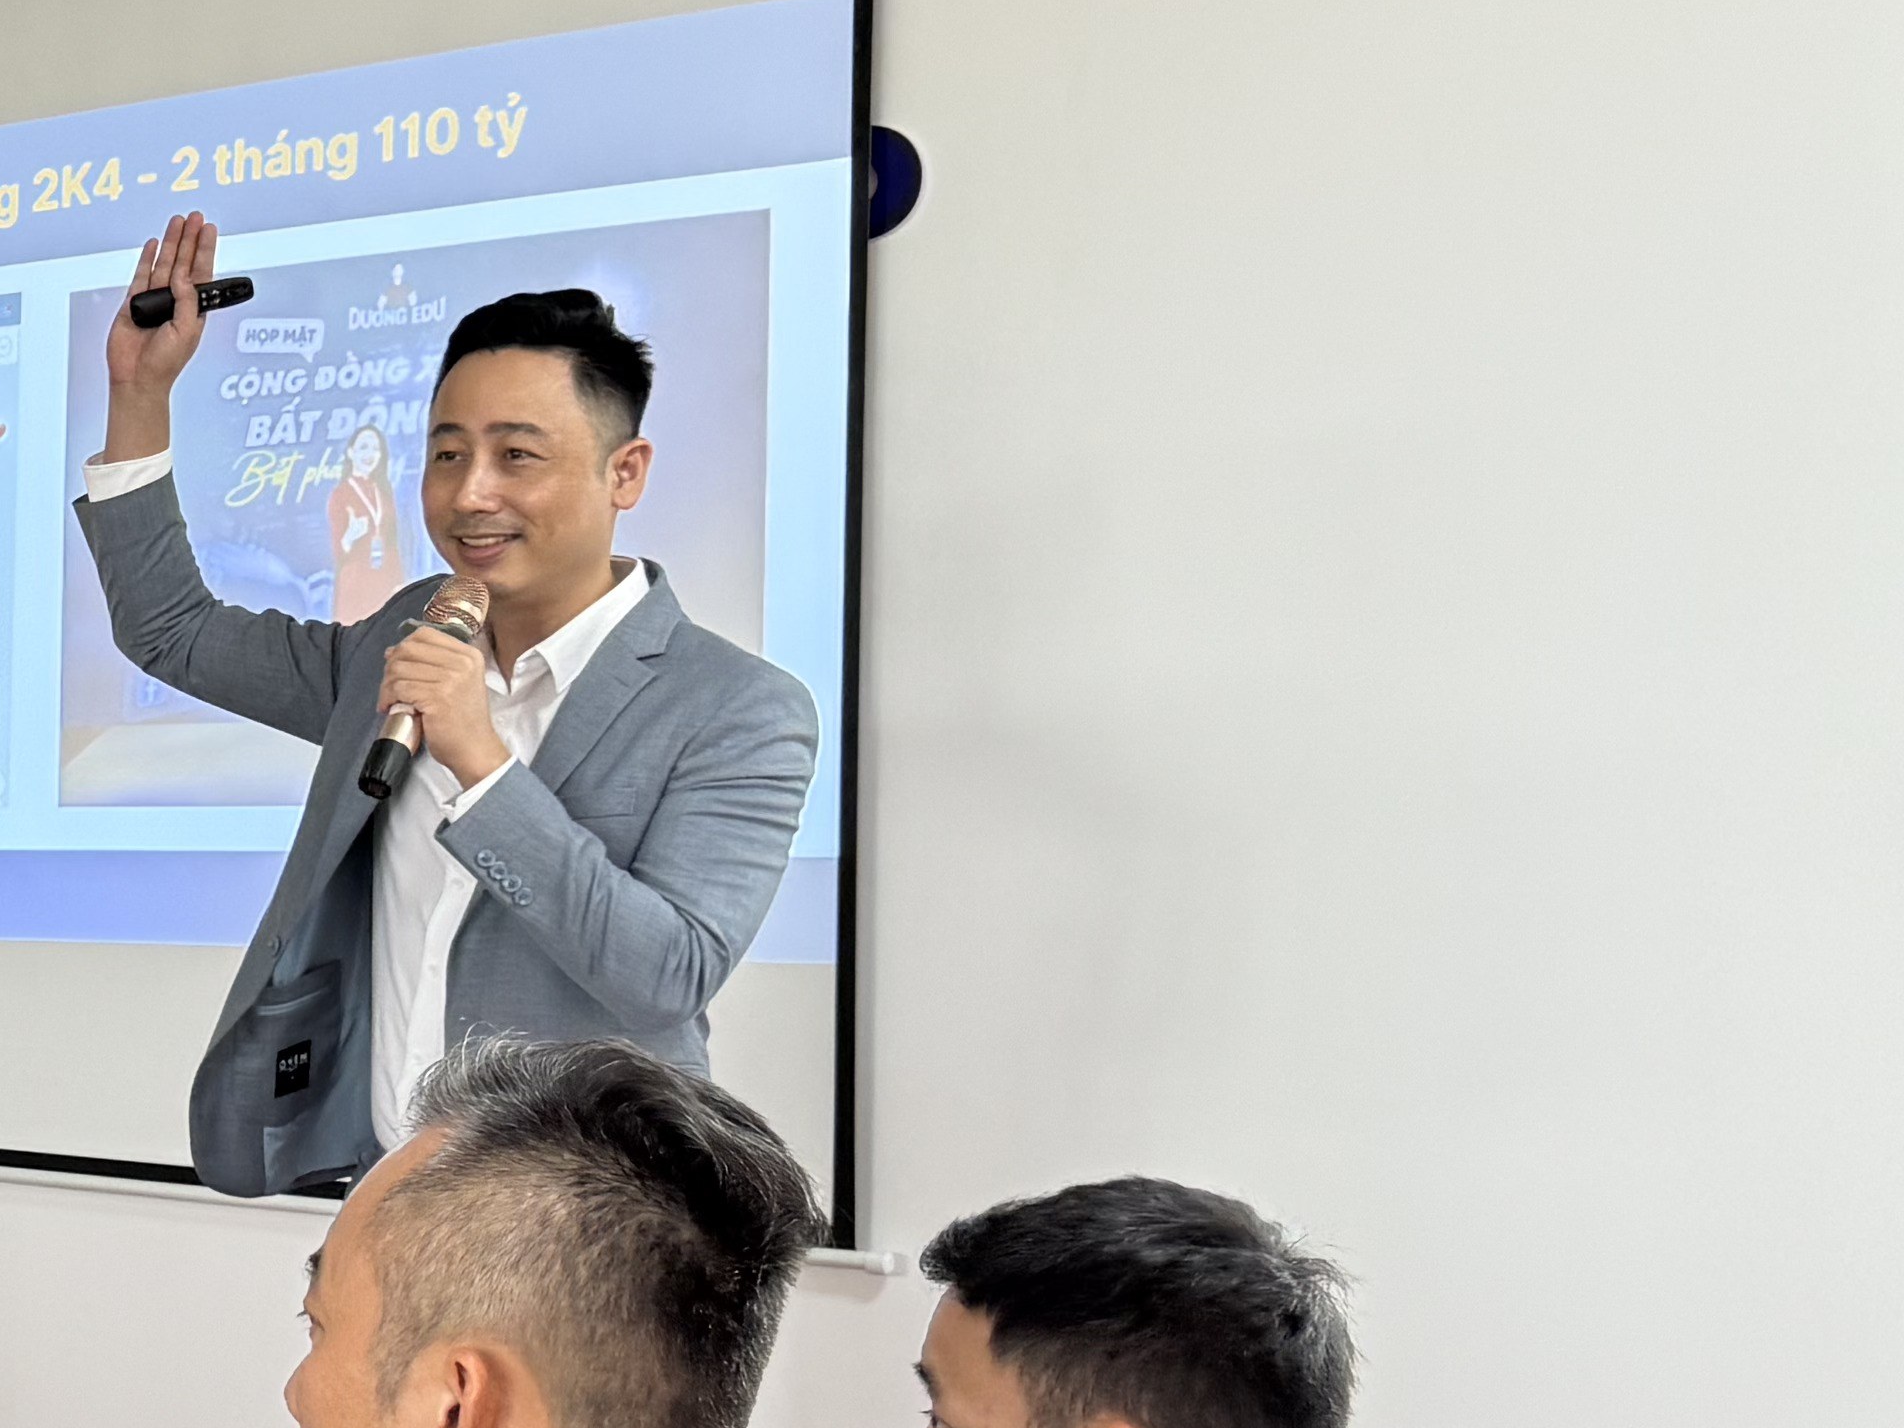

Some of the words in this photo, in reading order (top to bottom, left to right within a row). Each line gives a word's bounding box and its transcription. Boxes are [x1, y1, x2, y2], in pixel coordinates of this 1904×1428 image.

[31, 156, 124, 213] 2K4
[170, 145, 201, 192] 2
[212, 129, 359, 181] tháng
[373, 106, 461, 163] 110
[474, 91, 528, 158] tỷ
[411, 296, 446, 324] EDU
[245, 328, 280, 349] HỌP
[282, 325, 317, 348] MẶT
[220, 366, 308, 405] CỘNG
[314, 350, 410, 391] ĐỒNG
[244, 396, 324, 448] BẤT
